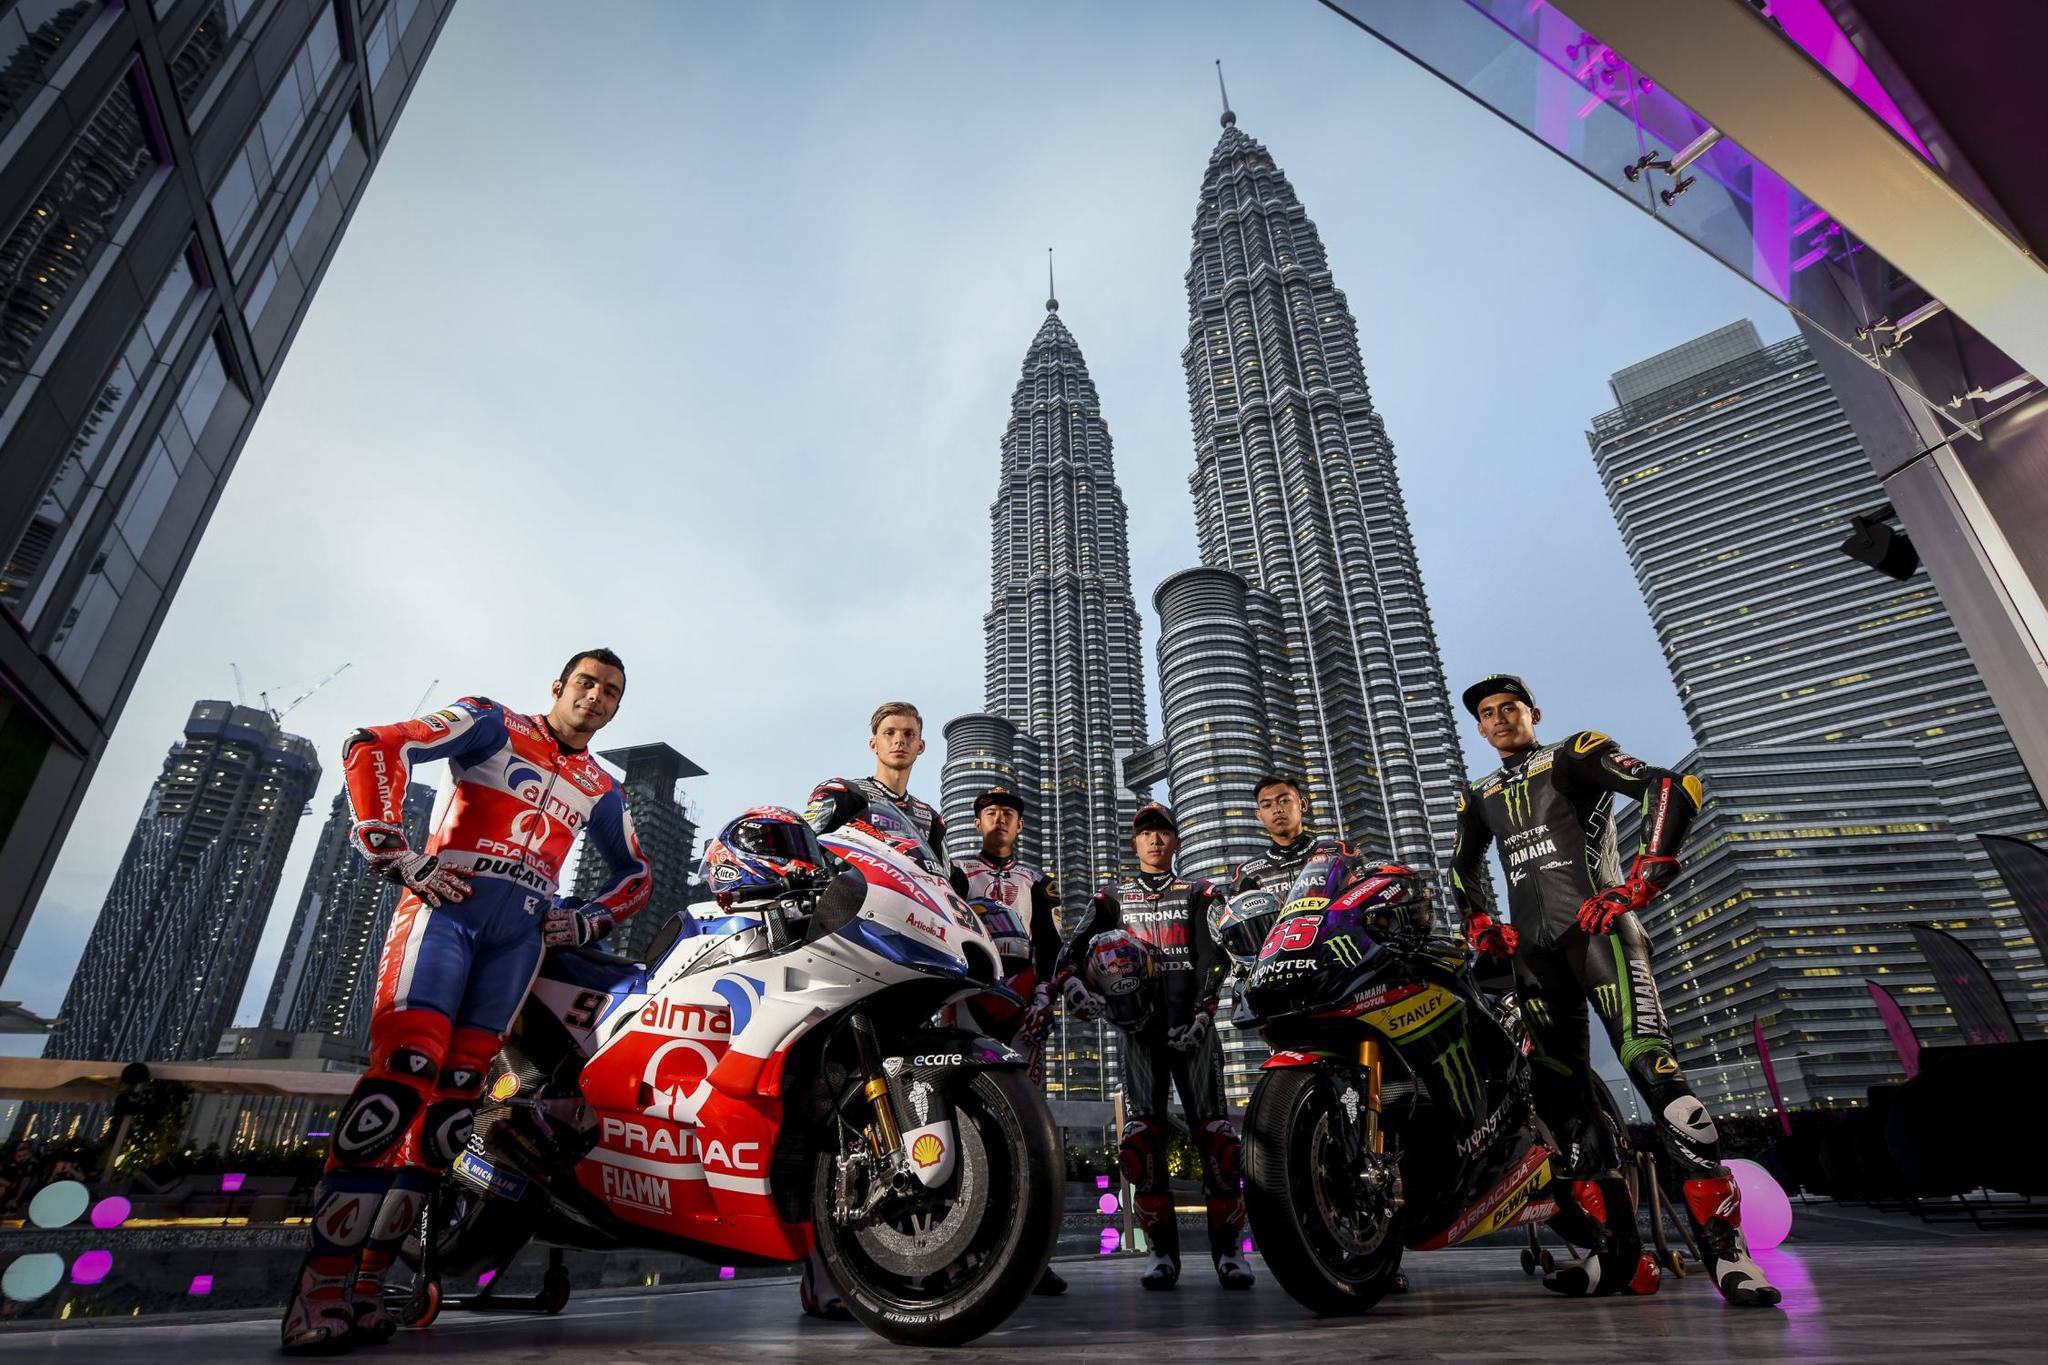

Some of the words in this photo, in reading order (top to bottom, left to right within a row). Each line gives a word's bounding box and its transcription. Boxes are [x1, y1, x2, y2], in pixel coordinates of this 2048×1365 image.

[504, 717, 531, 735] FIAMM
[371, 750, 395, 821] PRAMAC
[522, 785, 581, 828] alma
[1504, 824, 1550, 846] MONSTER
[476, 838, 552, 877] PRAMAC
[1508, 840, 1557, 867] YAMAHA
[473, 857, 549, 892] DUCATI
[713, 866, 735, 881] X-lite
[843, 851, 930, 903] PRAMAC
[610, 885, 649, 914] PRAMAC
[1244, 899, 1266, 909] SHOEI
[1122, 909, 1190, 924] PETRONAS
[1258, 914, 1324, 961] 55
[1112, 979, 1138, 990] Arai
[1259, 972, 1304, 985] NERGY
[1354, 984, 1387, 1003] YAMAHA
[1355, 996, 1387, 1010] MOTUL
[1629, 959, 1660, 1035] YAMAHA
[641, 997, 731, 1034] alma
[1389, 994, 1443, 1031] STANLEY
[913, 1053, 963, 1067] ecare
[602, 1117, 760, 1171] PRAMAC
[470, 1163, 517, 1192] MICHELIN
[602, 1165, 673, 1210] FIAMM
[1447, 1163, 1529, 1243] BARRACUDA
